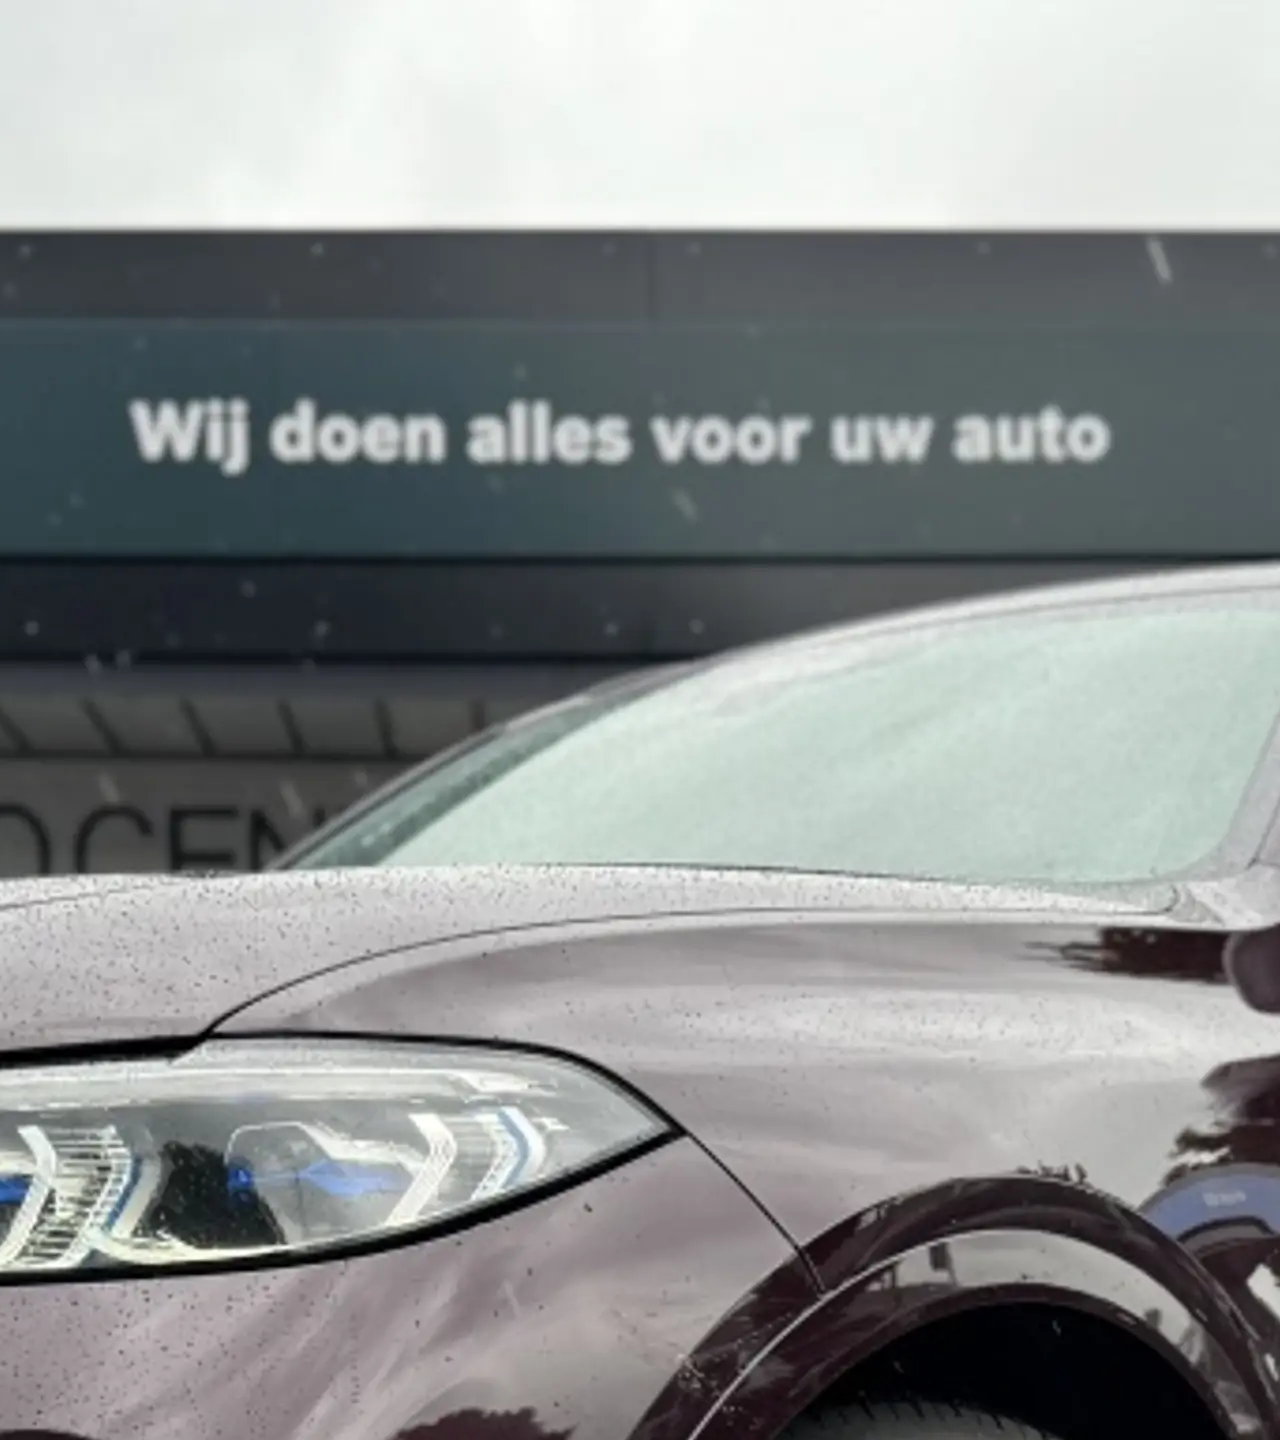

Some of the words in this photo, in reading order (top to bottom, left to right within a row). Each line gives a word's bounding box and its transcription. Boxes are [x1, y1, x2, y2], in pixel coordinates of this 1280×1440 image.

[131, 398, 248, 474] Wij
[270, 399, 445, 464] doen
[467, 400, 631, 464] alles
[652, 416, 810, 464] voor
[831, 416, 933, 463] uw
[953, 406, 1111, 463] auto
